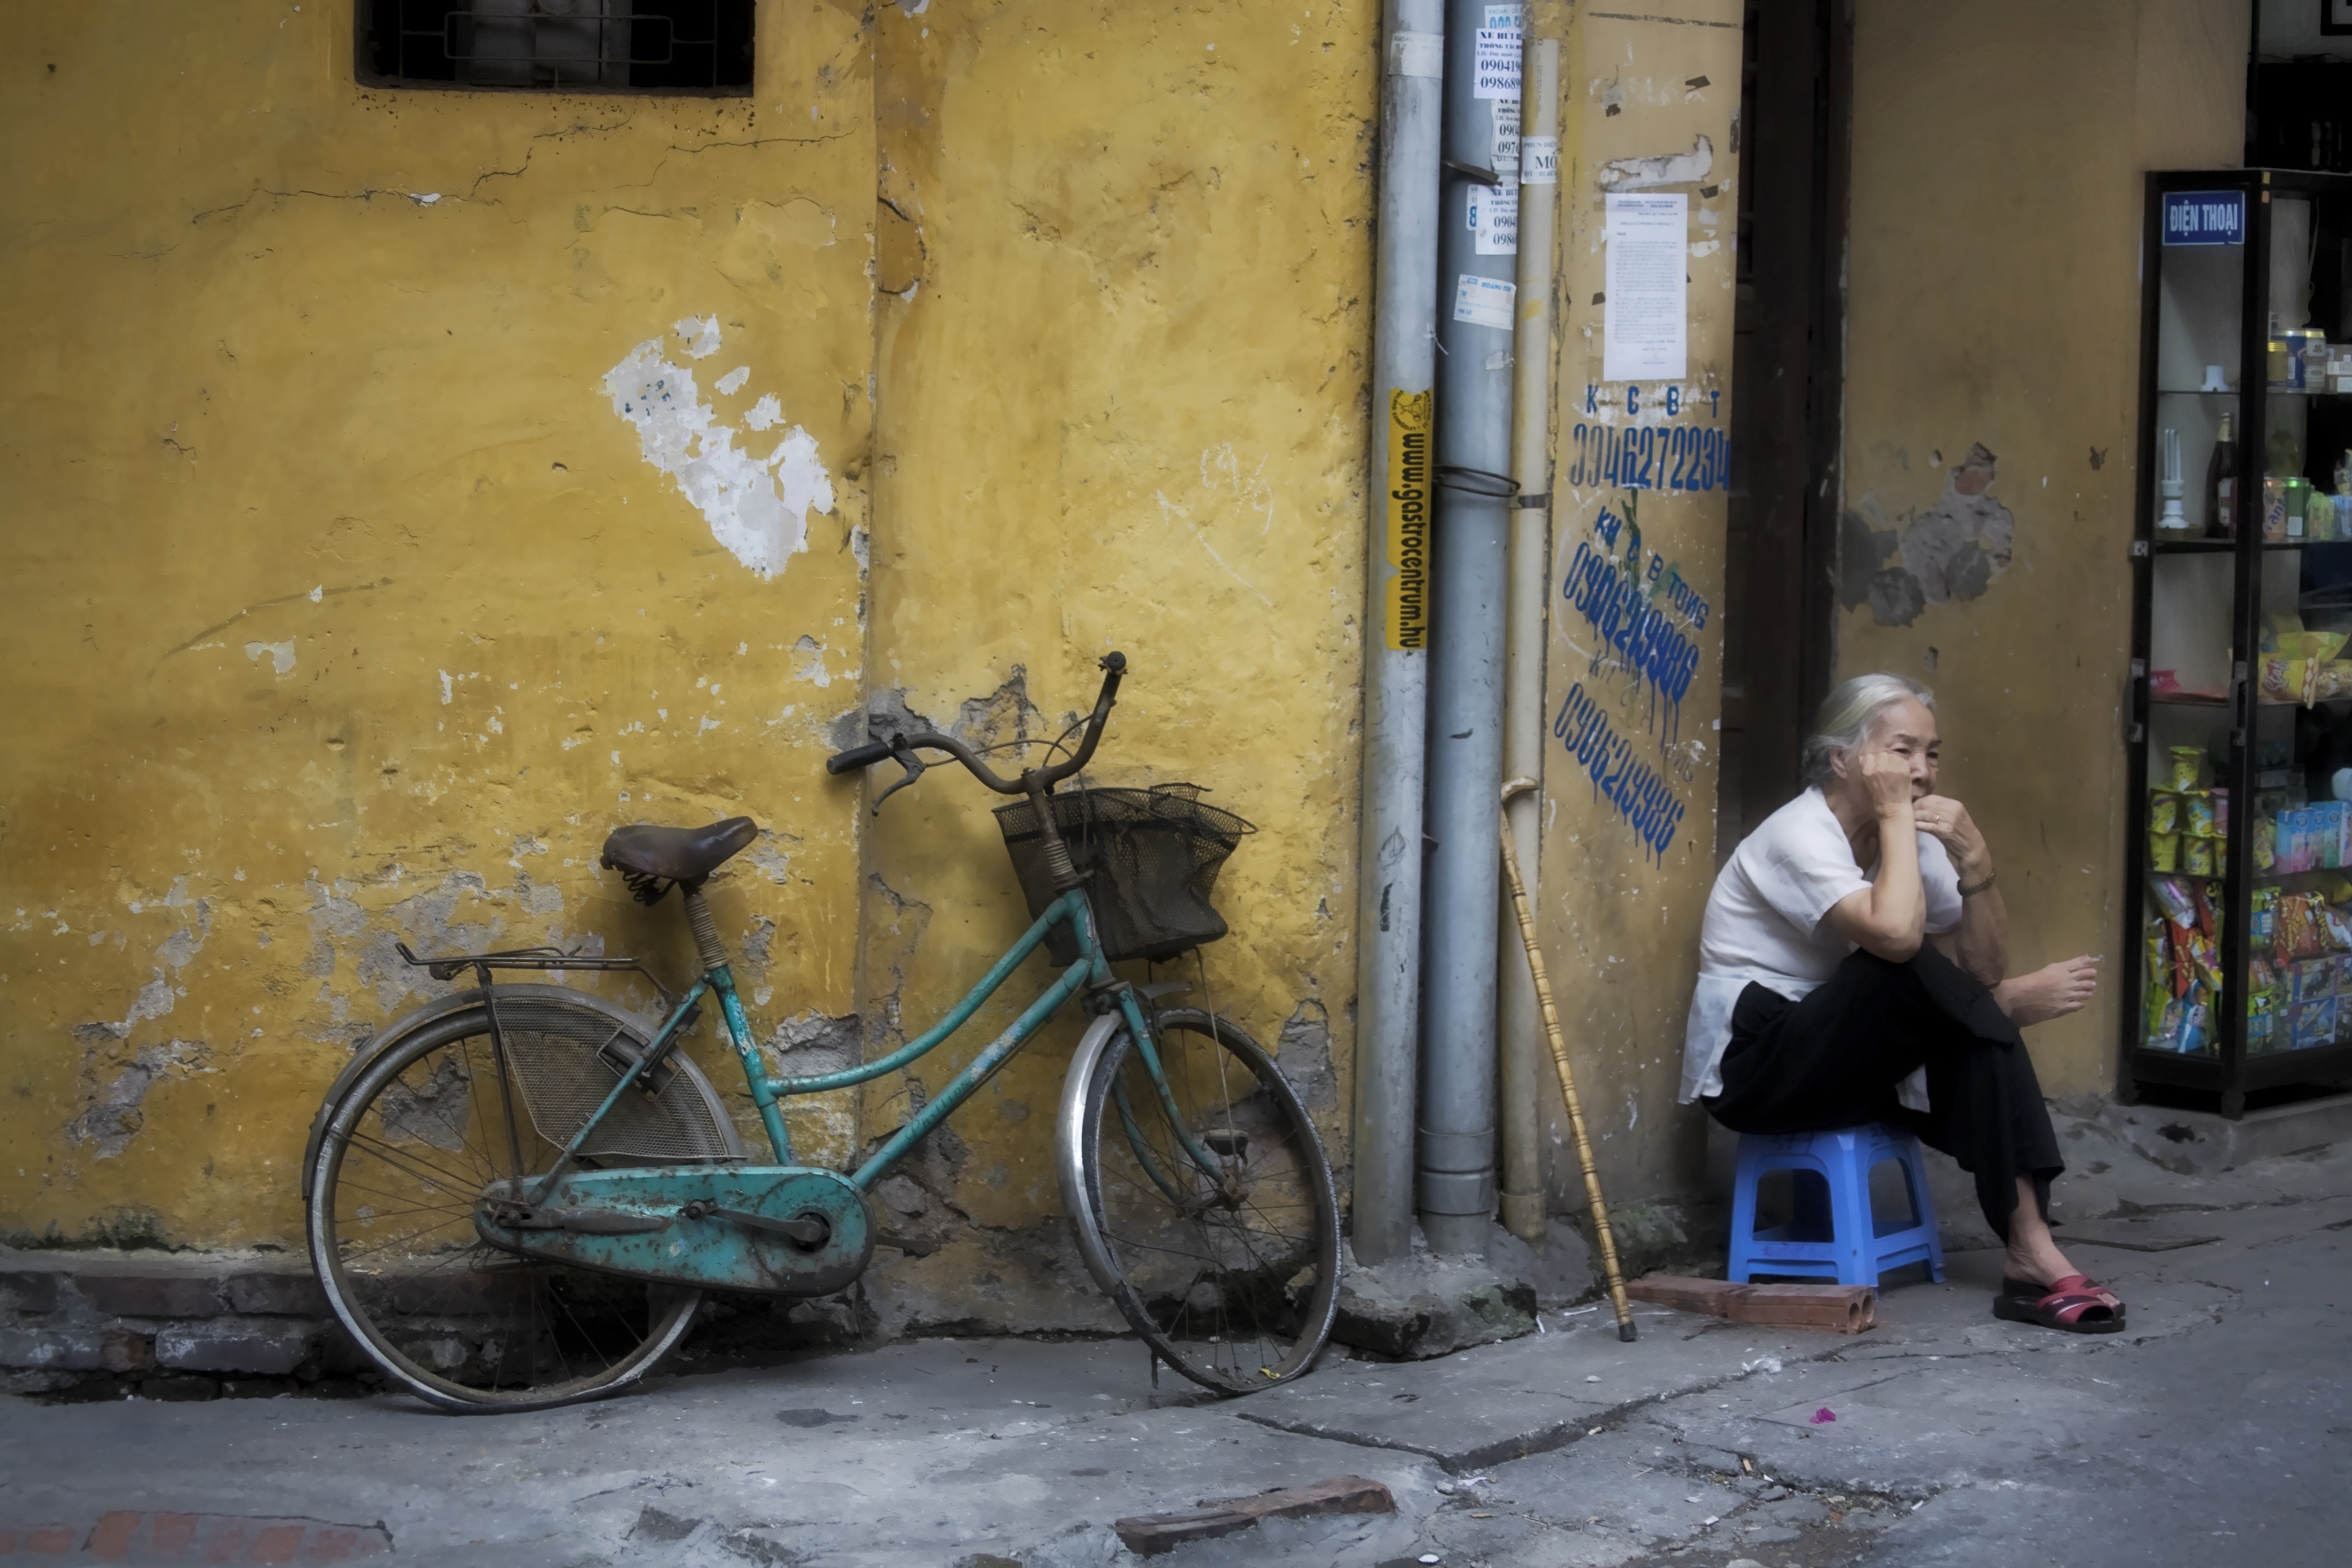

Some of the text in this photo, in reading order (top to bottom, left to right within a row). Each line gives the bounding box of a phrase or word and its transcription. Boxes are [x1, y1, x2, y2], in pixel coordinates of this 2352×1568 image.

[2170, 199, 2238, 236] ĐIỆN THOẠI
[1392, 432, 1426, 648] www.gastrocentrum.hu
